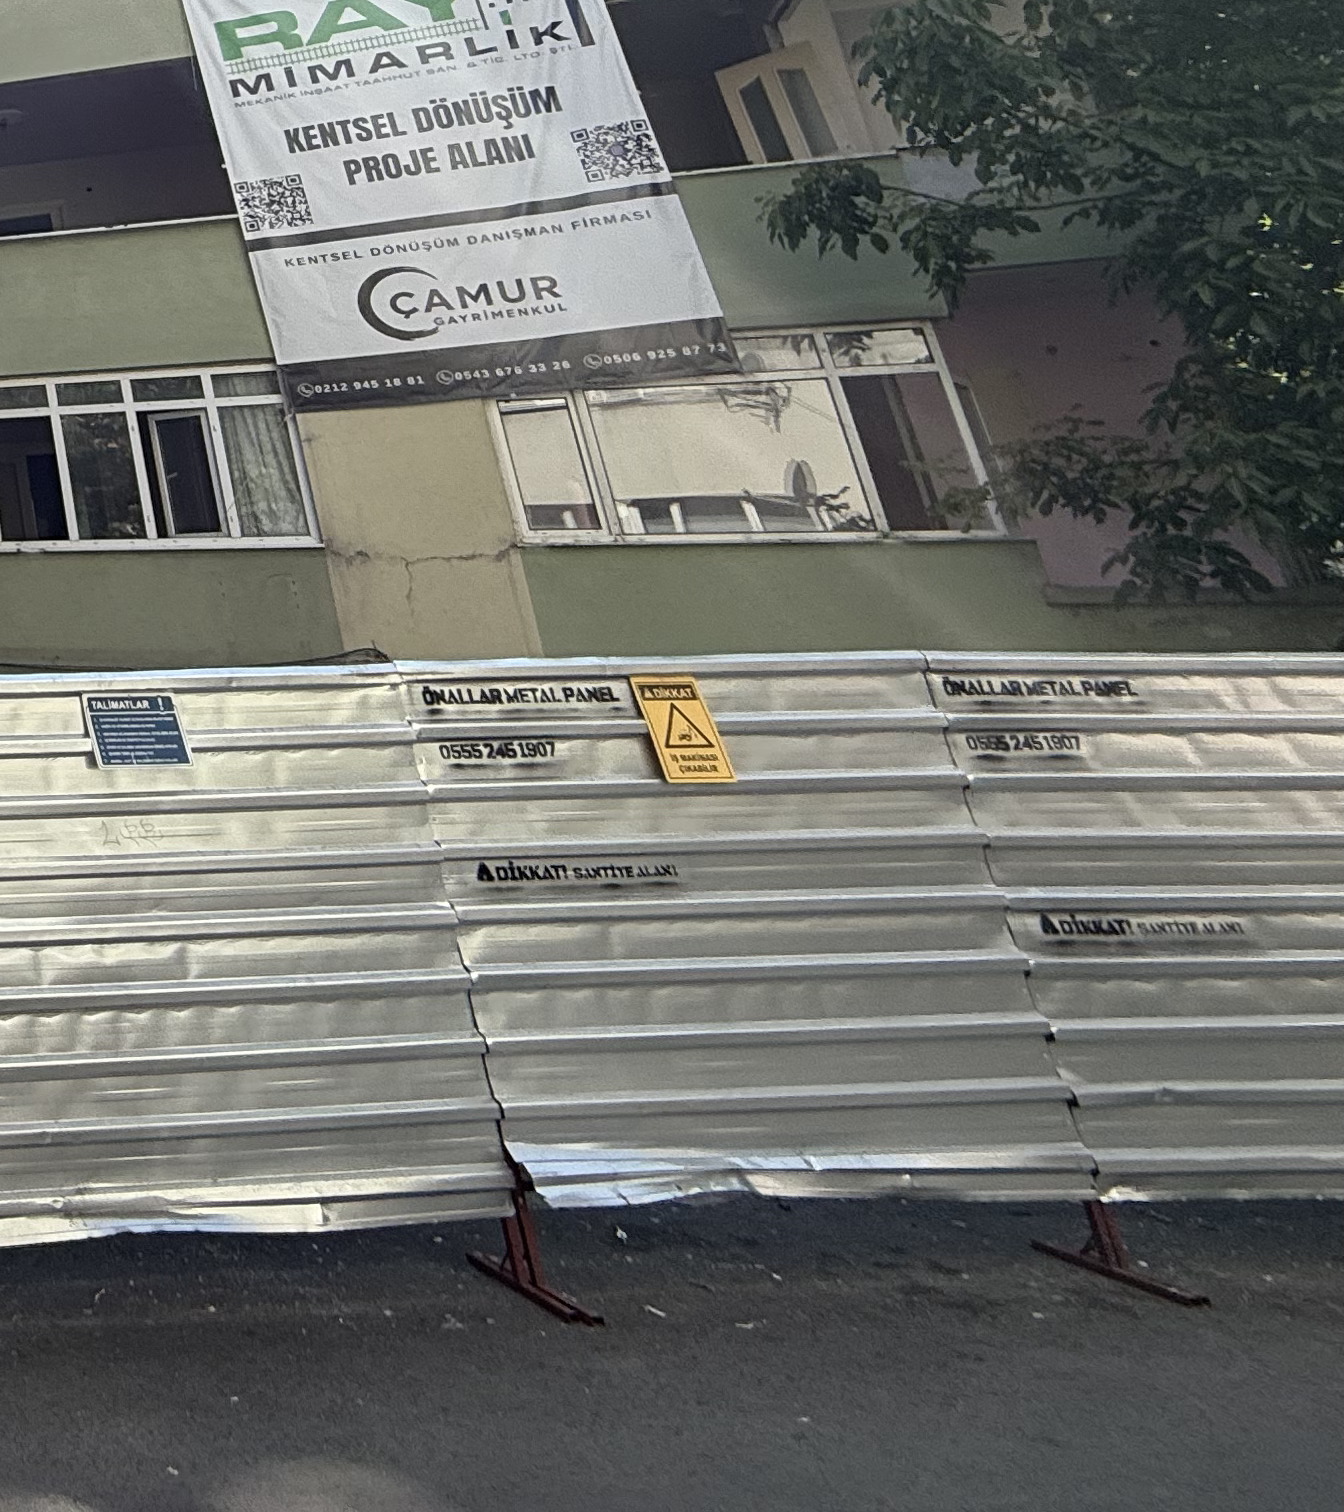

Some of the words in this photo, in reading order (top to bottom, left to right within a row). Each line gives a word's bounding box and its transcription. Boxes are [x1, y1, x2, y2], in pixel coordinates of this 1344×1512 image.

[234, 91, 297, 108] MEKANİK
[284, 112, 407, 153] KENTSEL
[412, 85, 563, 133] DÖNÜŞÜM
[343, 147, 441, 185] PROJE
[447, 134, 536, 170] ALANI
[284, 249, 364, 268] KENTSEL
[370, 235, 461, 258] DÖNÜŞÜM
[467, 223, 564, 248] DANIŞMAN
[571, 209, 653, 231] FİRMASI
[389, 275, 563, 319] ÇAMUR
[433, 303, 568, 327] GAYRİMENKUL
[314, 381, 349, 394] 0212
[454, 369, 490, 381] 0543
[528, 362, 547, 373] 33
[603, 353, 642, 365] 0506
[647, 348, 677, 360] 925
[422, 685, 503, 706] ÖNALLAR
[504, 687, 561, 704] METAL
[563, 686, 620, 703] PANEL
[653, 687, 693, 699] DİKKAT
[1023, 680, 1080, 696] METAL
[1081, 680, 1138, 697] PANEL
[91, 699, 150, 710] TALİMATLAR
